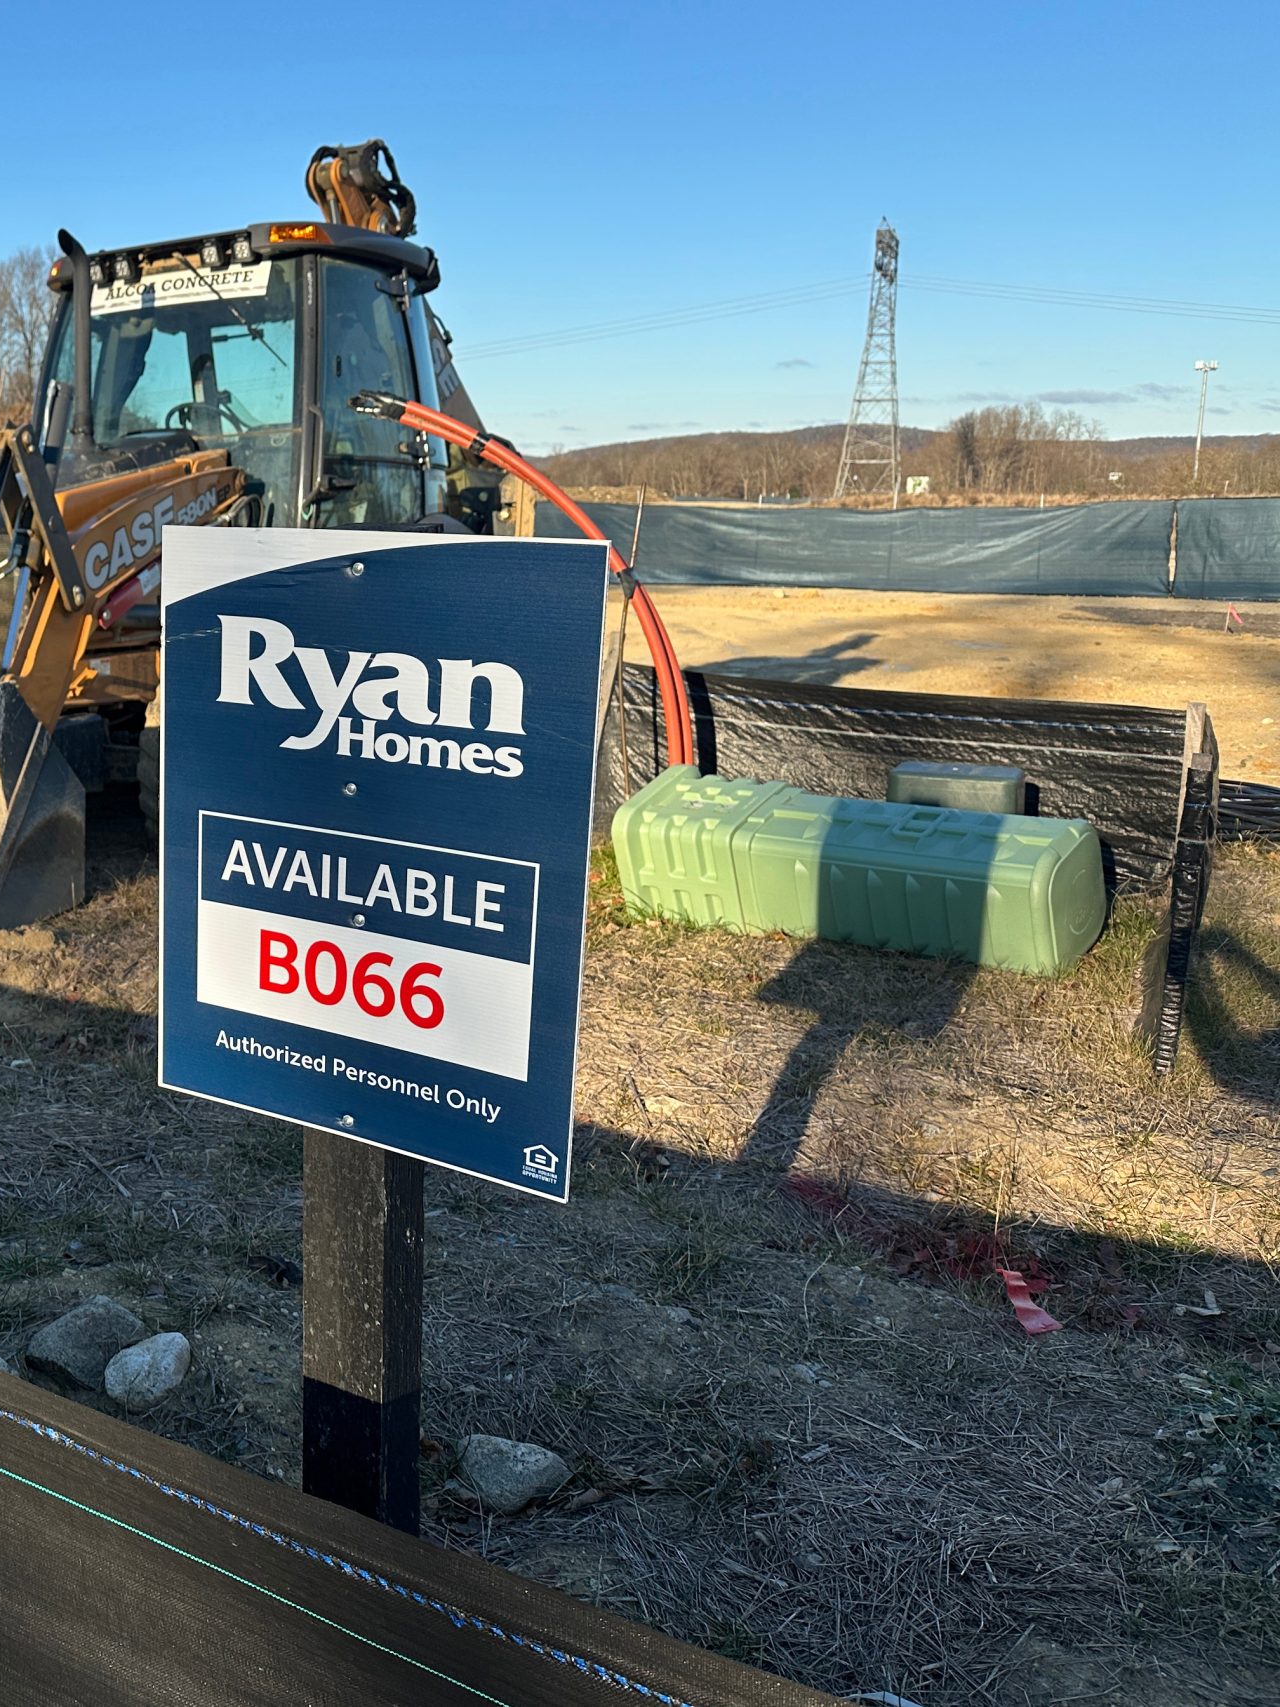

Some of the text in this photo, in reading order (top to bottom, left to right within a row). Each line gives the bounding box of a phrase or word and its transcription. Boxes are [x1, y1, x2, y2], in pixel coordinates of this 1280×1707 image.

[105, 282, 156, 301] ALCOA
[161, 270, 254, 292] CONCRETE
[176, 487, 218, 524] 580N
[216, 614, 527, 750] Ryan
[336, 716, 524, 778] Homes
[221, 839, 505, 933] AVAILABLE
[259, 928, 445, 1030] B066
[215, 1029, 501, 1124] Authorized Personnel Only
